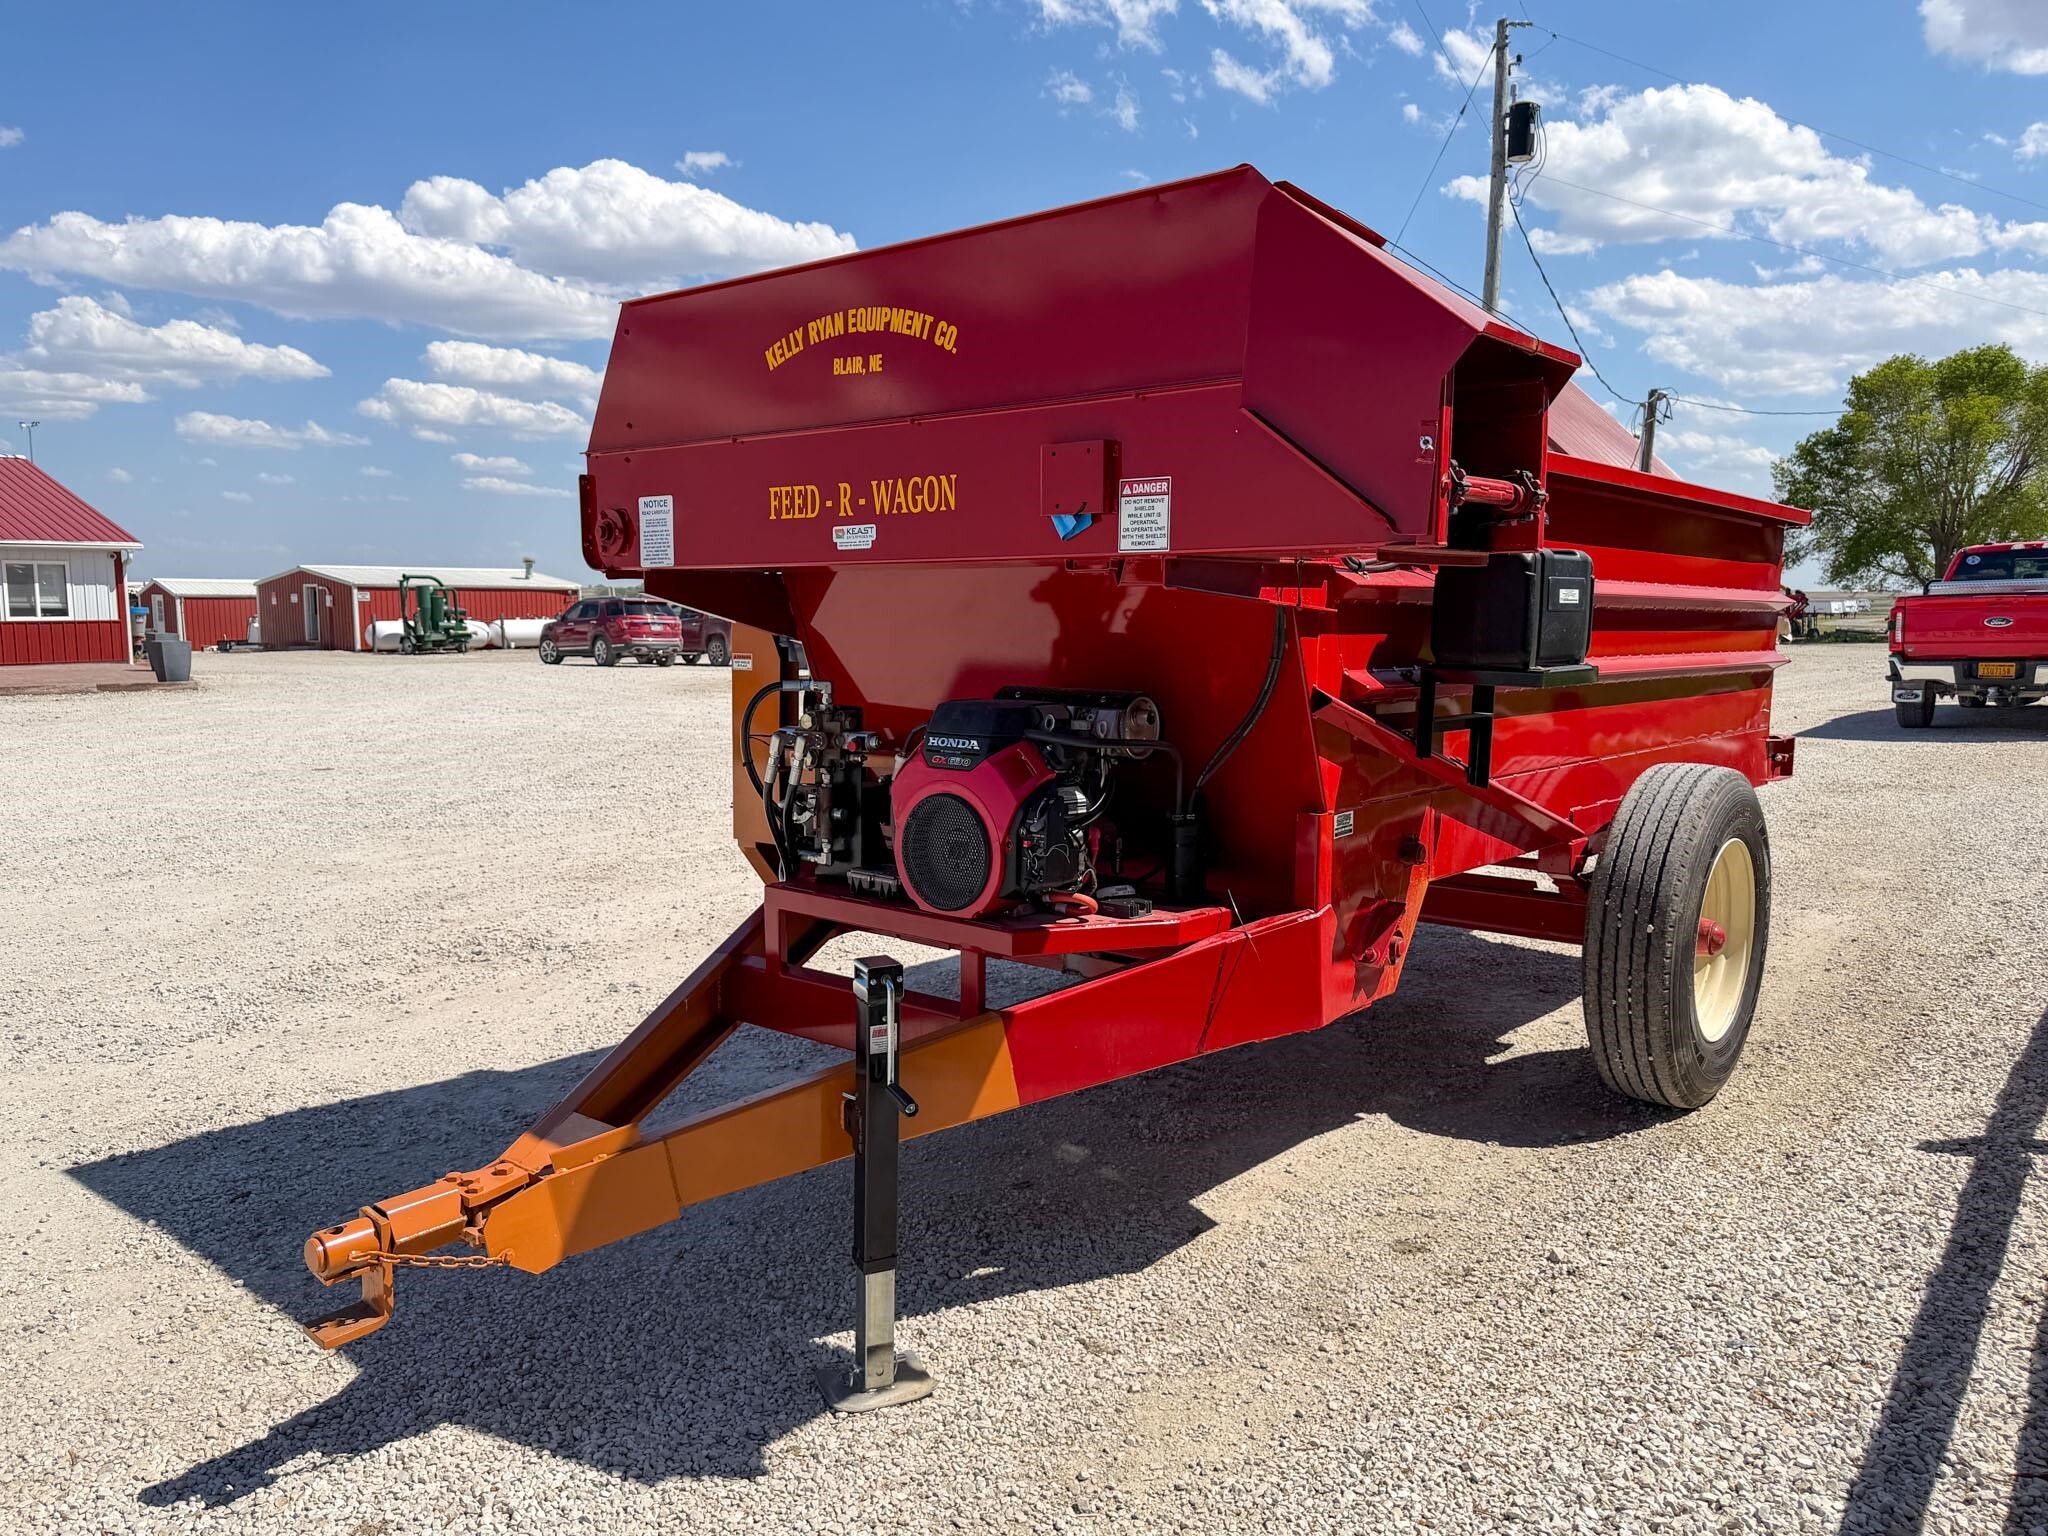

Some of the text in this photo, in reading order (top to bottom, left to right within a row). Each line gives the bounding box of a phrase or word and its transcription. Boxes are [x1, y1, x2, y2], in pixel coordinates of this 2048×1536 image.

[764, 306, 958, 371] KELLY RYAN EQUIPMENT CO.
[833, 353, 883, 376] BLAIR, NE
[1132, 482, 1168, 494] DANGER
[643, 499, 668, 508] NOTICE
[768, 484, 820, 520] FEED
[838, 482, 854, 517] R
[870, 474, 957, 515] WAGON
[846, 526, 874, 535] KEAST
[927, 736, 980, 750] HONDA
